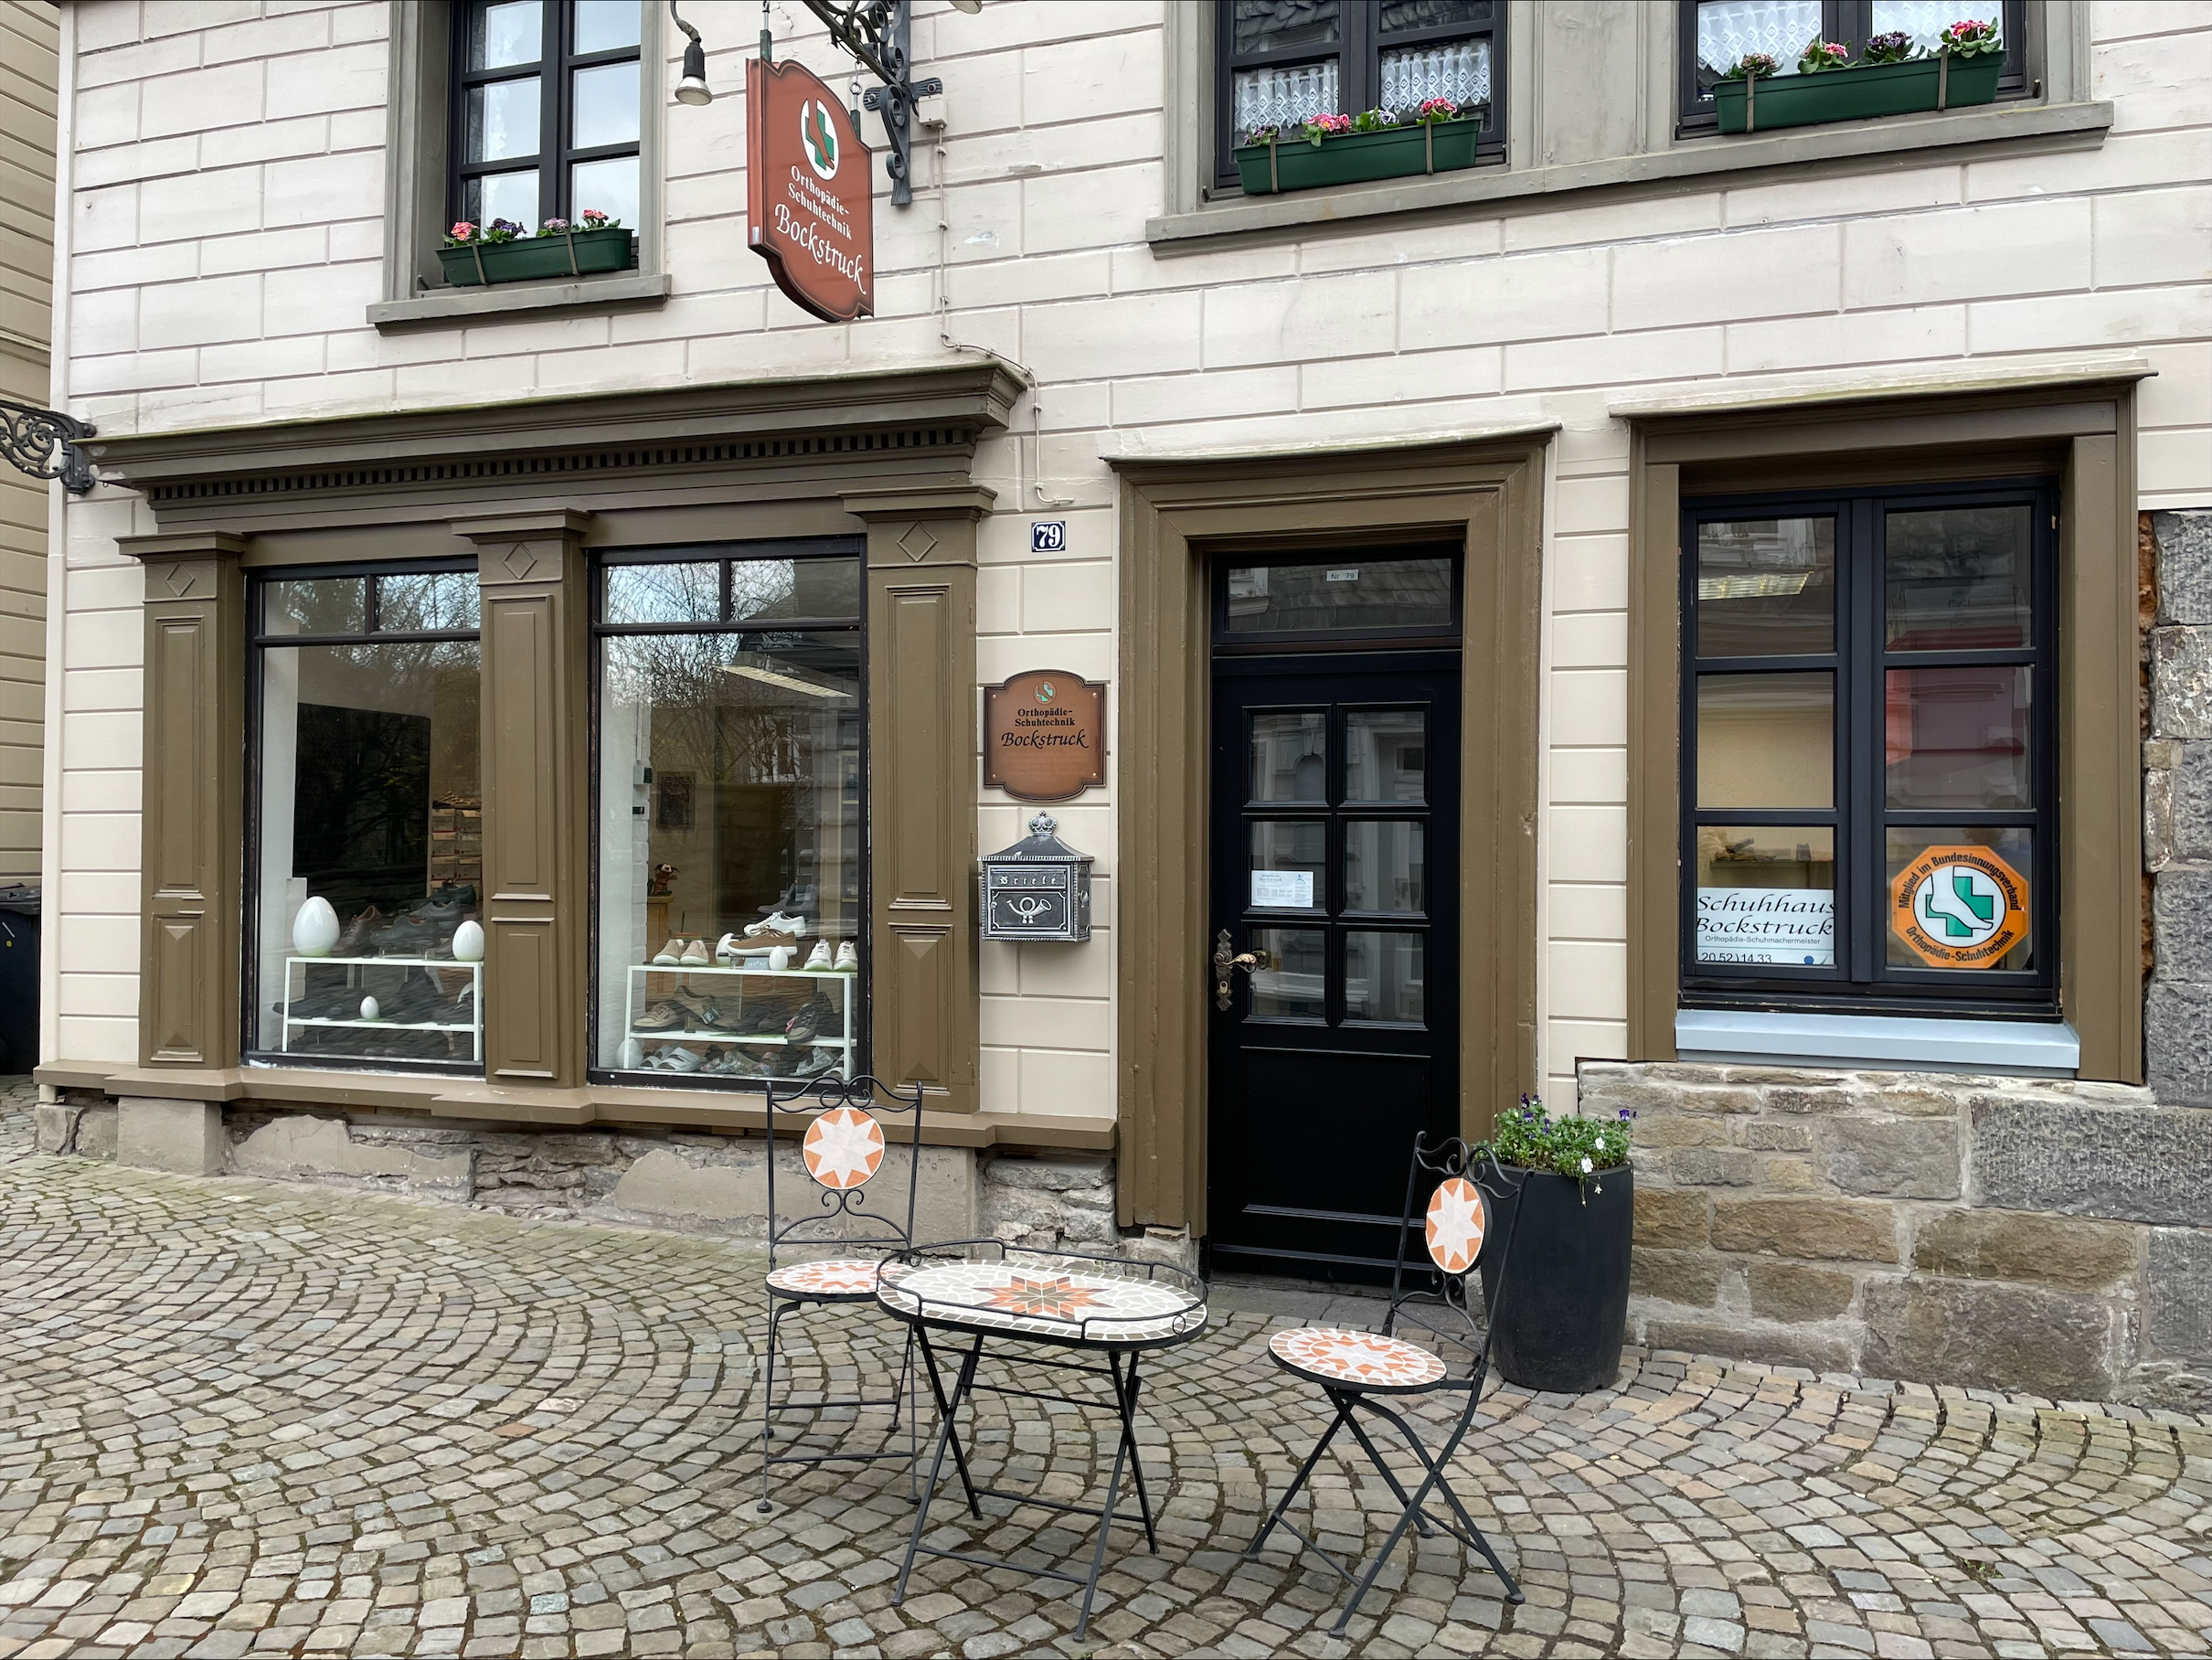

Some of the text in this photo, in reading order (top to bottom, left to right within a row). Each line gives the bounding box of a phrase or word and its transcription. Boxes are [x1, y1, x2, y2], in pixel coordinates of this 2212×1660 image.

[791, 165, 850, 215] Orthopädie-
[788, 182, 852, 240] Schuhtechnik
[774, 203, 867, 294] Bockstruck
[1036, 525, 1060, 548] 79
[1015, 718, 1075, 727] Schuhtechnik
[1017, 708, 1073, 718] Orthopädie-
[1001, 729, 1089, 749] Bockstruck
[1000, 876, 1057, 885] Briefe
[1898, 852, 2022, 910] Mitglied im Bundesinnungsverband
[1697, 892, 1834, 913] Schuhhaus
[1696, 914, 1834, 935] Bockstruck
[1705, 935, 1821, 945] Orthopädie-Schuhmachermeister
